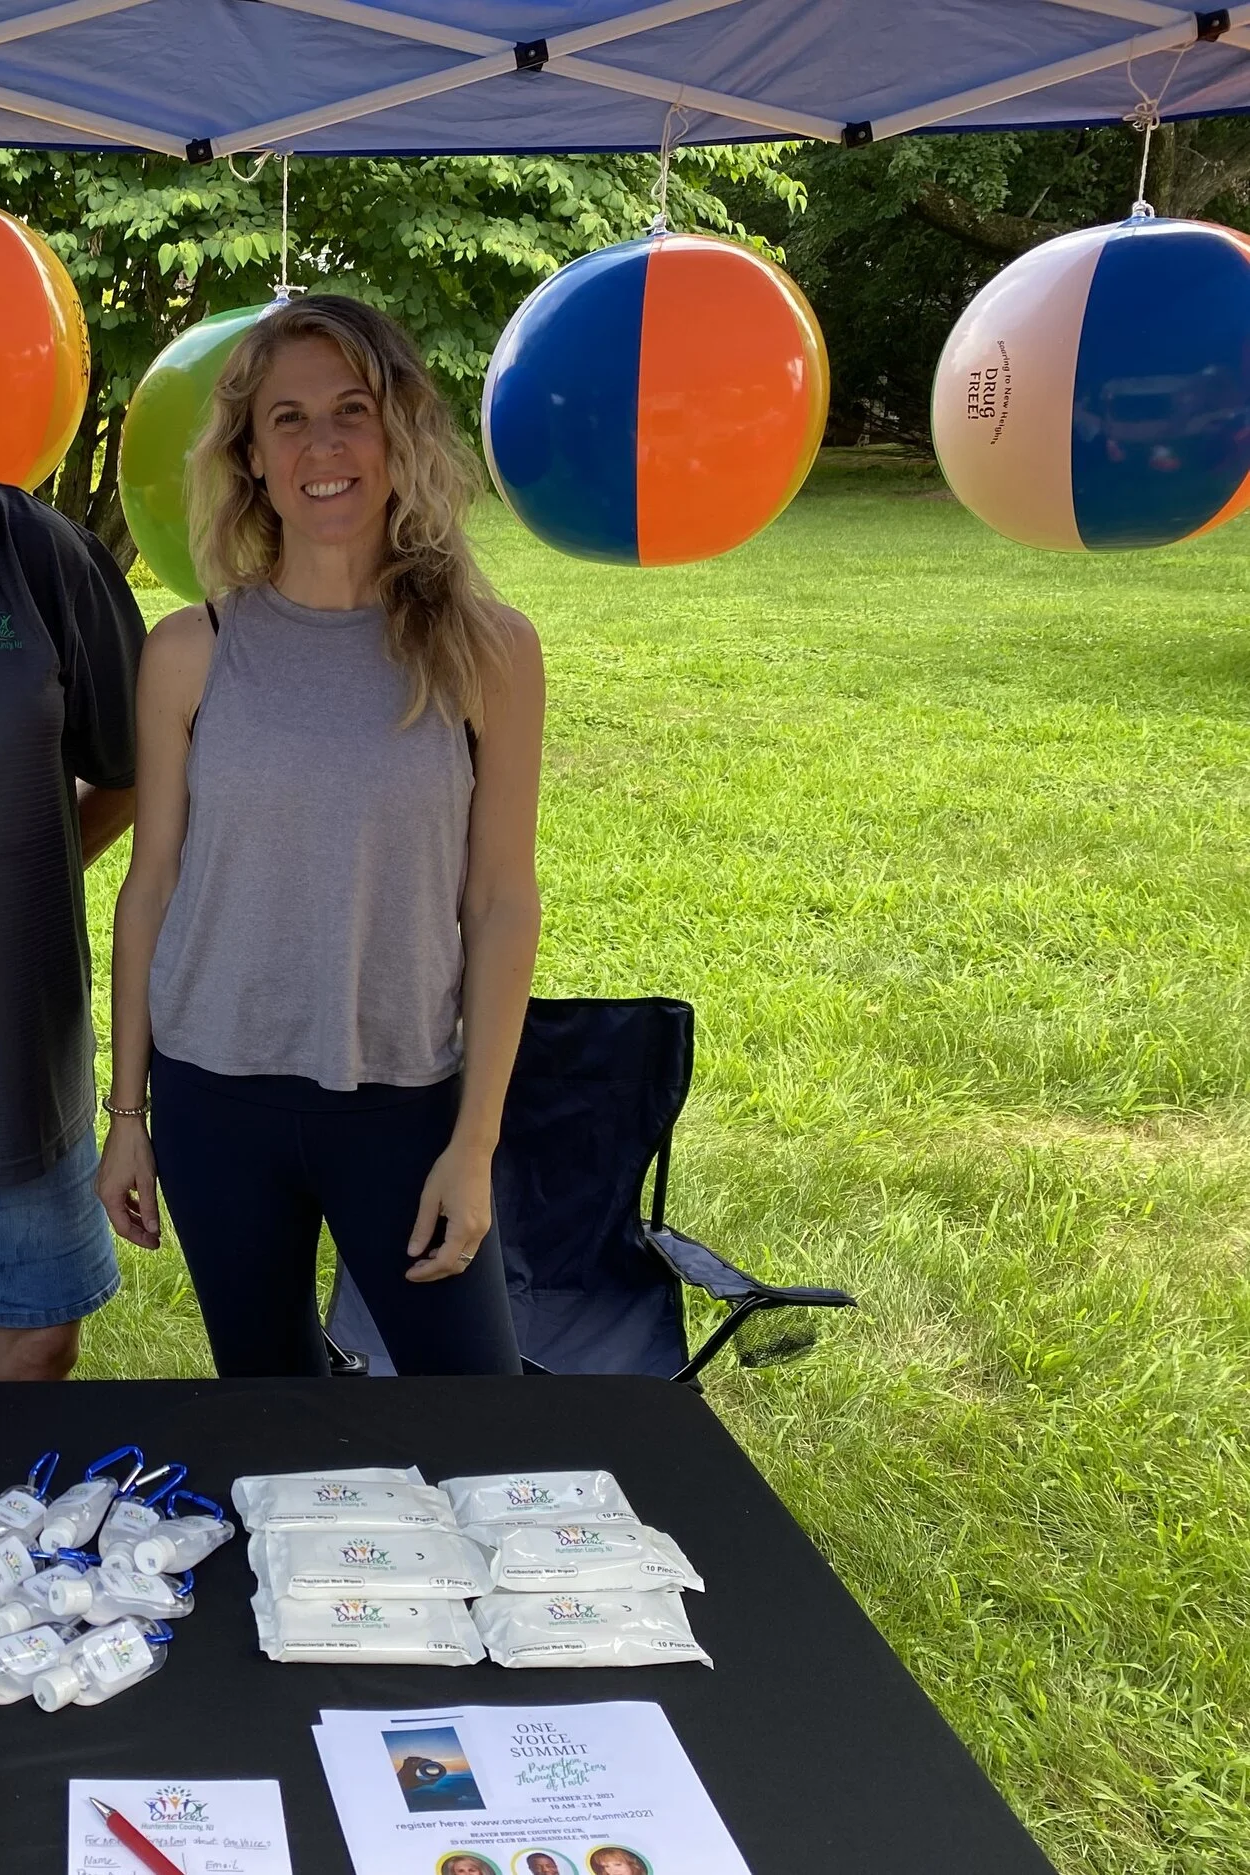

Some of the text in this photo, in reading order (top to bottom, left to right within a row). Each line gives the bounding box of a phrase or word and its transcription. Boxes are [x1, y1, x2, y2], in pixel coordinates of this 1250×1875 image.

[968, 371, 982, 420] FREE!
[990, 340, 1012, 445] Soaring to New Heights
[516, 1722, 557, 1734] ONE
[511, 1733, 572, 1746] VOICE
[510, 1744, 590, 1758] SUMMIT
[528, 1757, 582, 1774] Prevention
[514, 1761, 608, 1786] Through the Lens
[545, 1772, 590, 1792] of Faith
[531, 1794, 582, 1803] SEPTEMBER
[597, 1792, 615, 1800] 2021
[561, 1802, 576, 1810] AM
[150, 1809, 210, 1823] OneVoice
[395, 1809, 654, 1831] register here: www.onevoicehc.com/summit2021
[141, 1823, 215, 1832] Hunterdon County, NJ
[83, 1855, 238, 1870] Name Email
